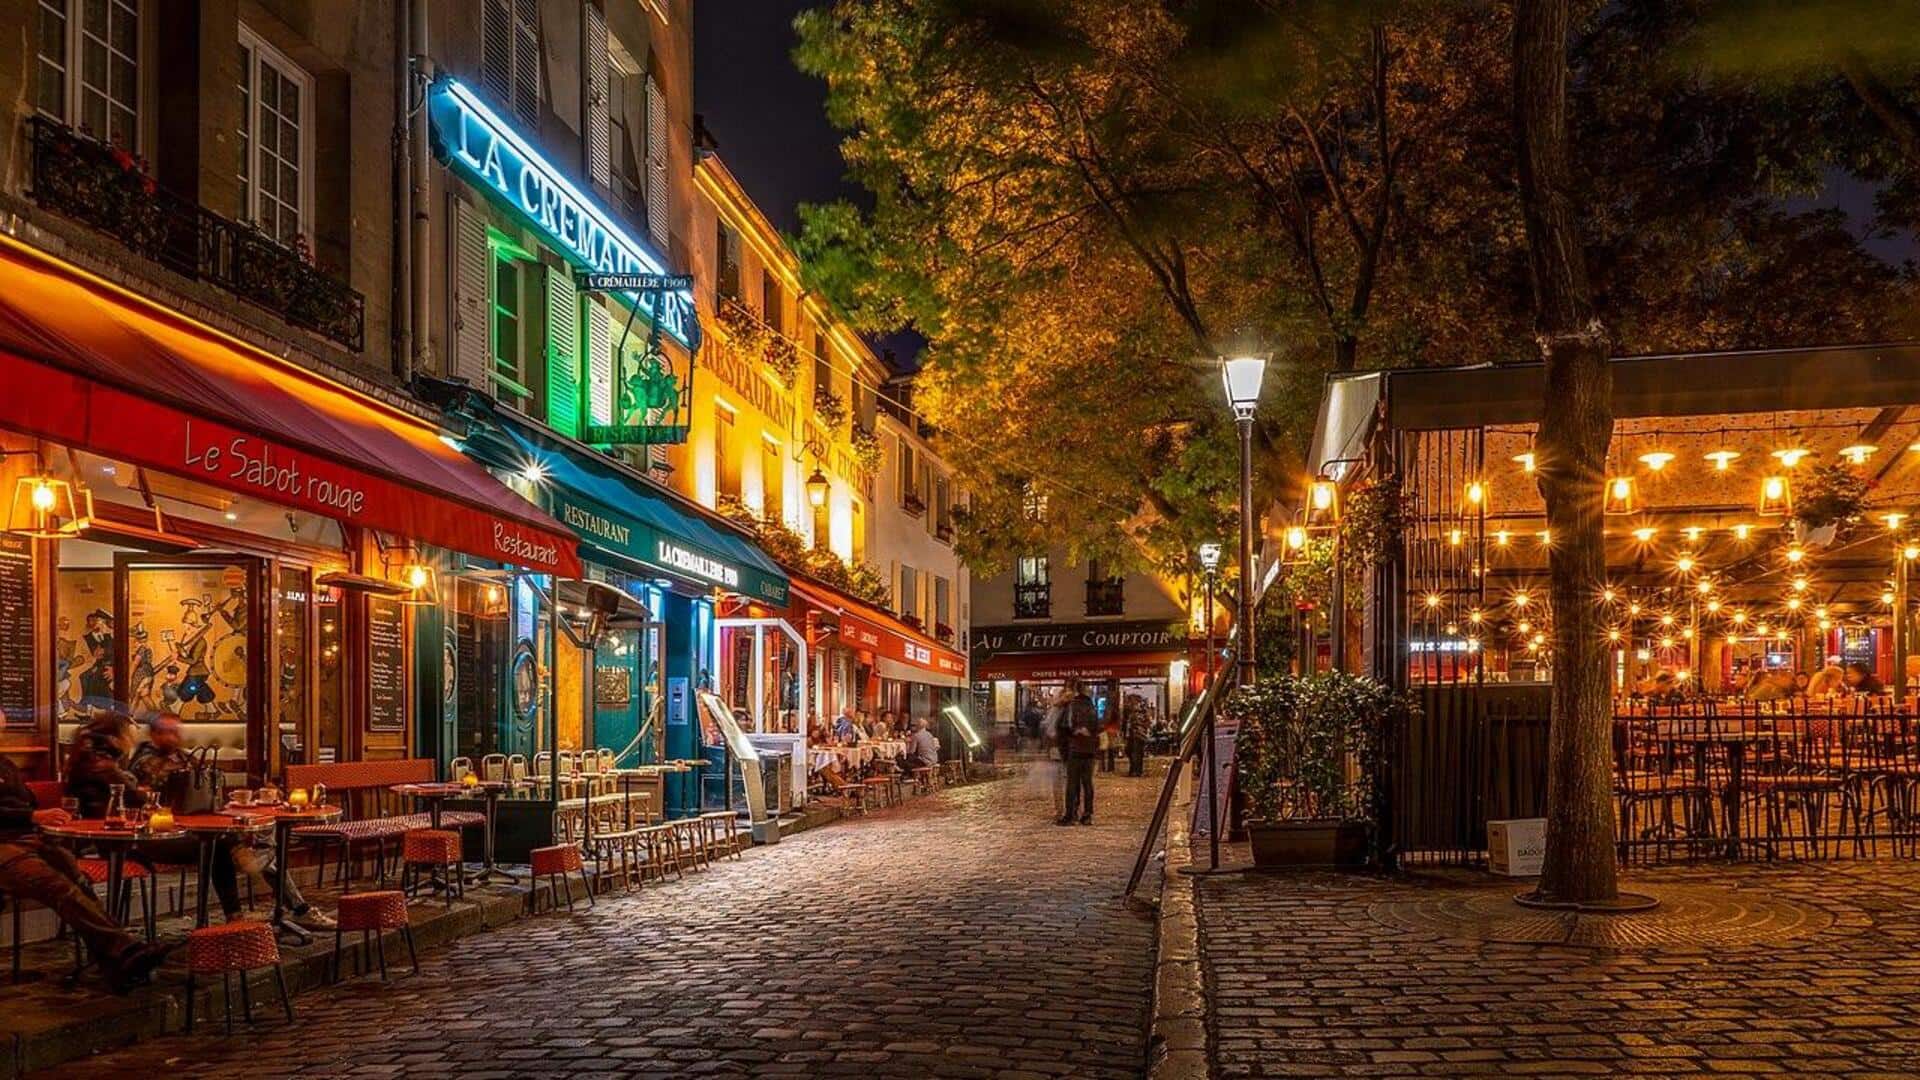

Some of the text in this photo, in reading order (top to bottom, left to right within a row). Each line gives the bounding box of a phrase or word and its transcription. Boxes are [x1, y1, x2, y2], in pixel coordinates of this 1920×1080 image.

[458, 104, 509, 192] LA
[703, 326, 793, 435] RESTAURANT
[184, 419, 560, 566] Le Sabot rouge Restaurant
[564, 503, 631, 546] RESTAURANT
[658, 540, 672, 565] LA
[973, 630, 1170, 649] AU PETIT COMPTOIR
[986, 671, 1007, 680] PIZZA
